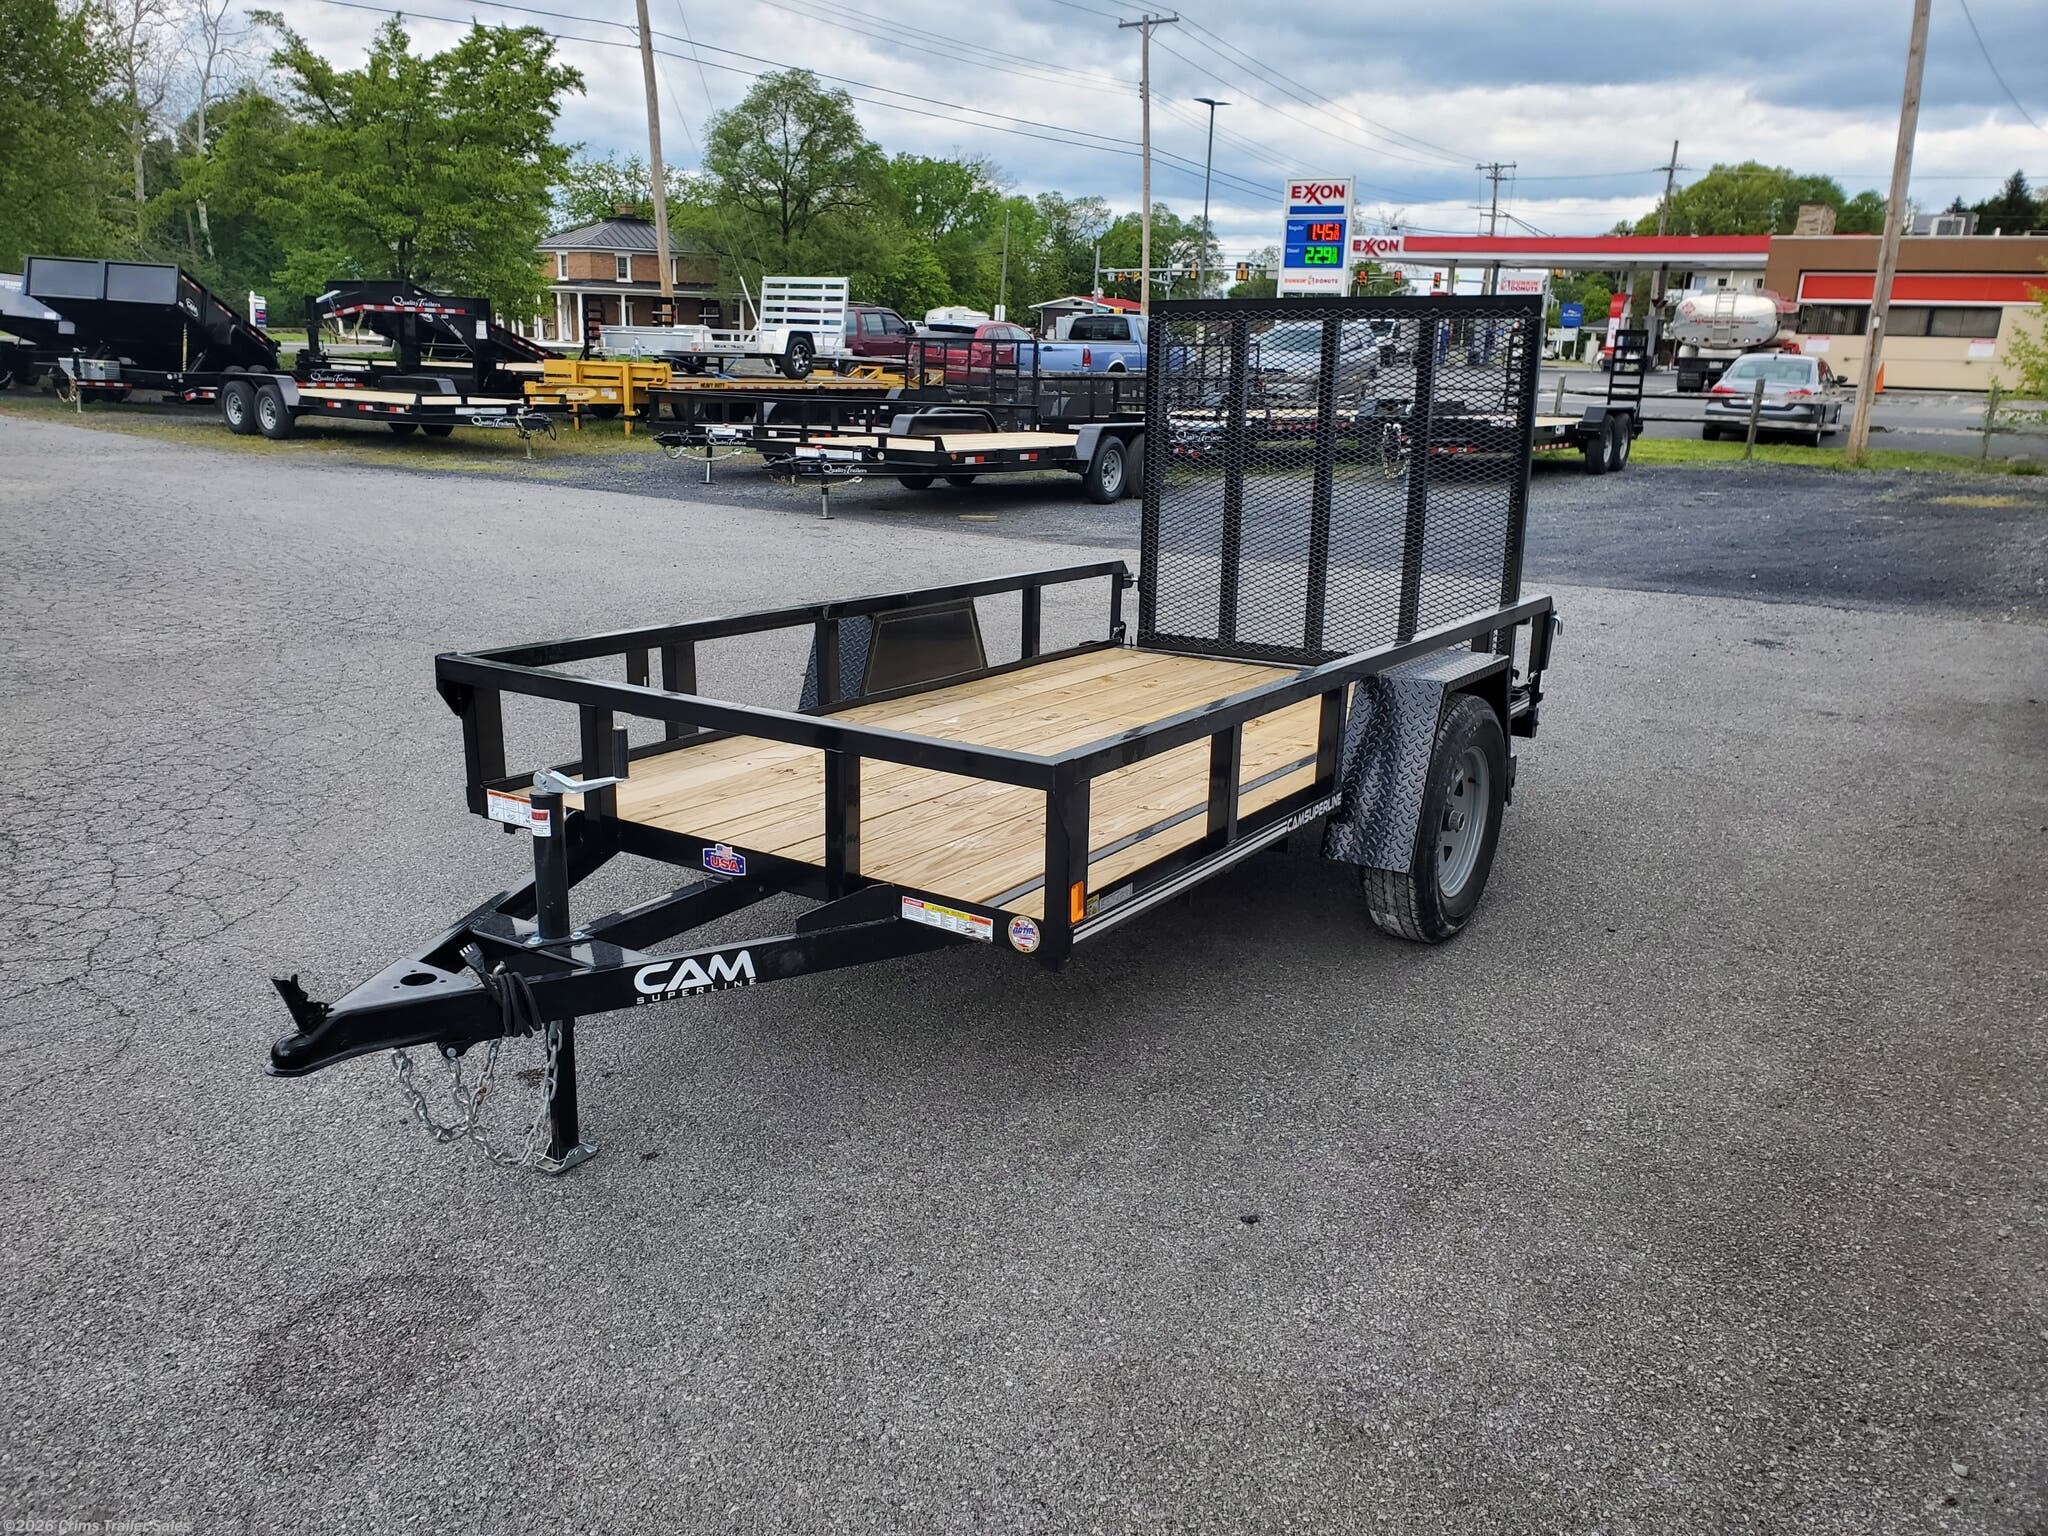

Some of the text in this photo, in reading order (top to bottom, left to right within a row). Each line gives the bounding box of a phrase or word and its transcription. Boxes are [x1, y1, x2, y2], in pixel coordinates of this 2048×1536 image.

[1291, 184, 1345, 205] EXXON
[1352, 238, 1400, 257] EXXON
[710, 855, 740, 872] USA
[634, 950, 756, 994] CAM
[636, 977, 757, 1005] SUPERLINE
